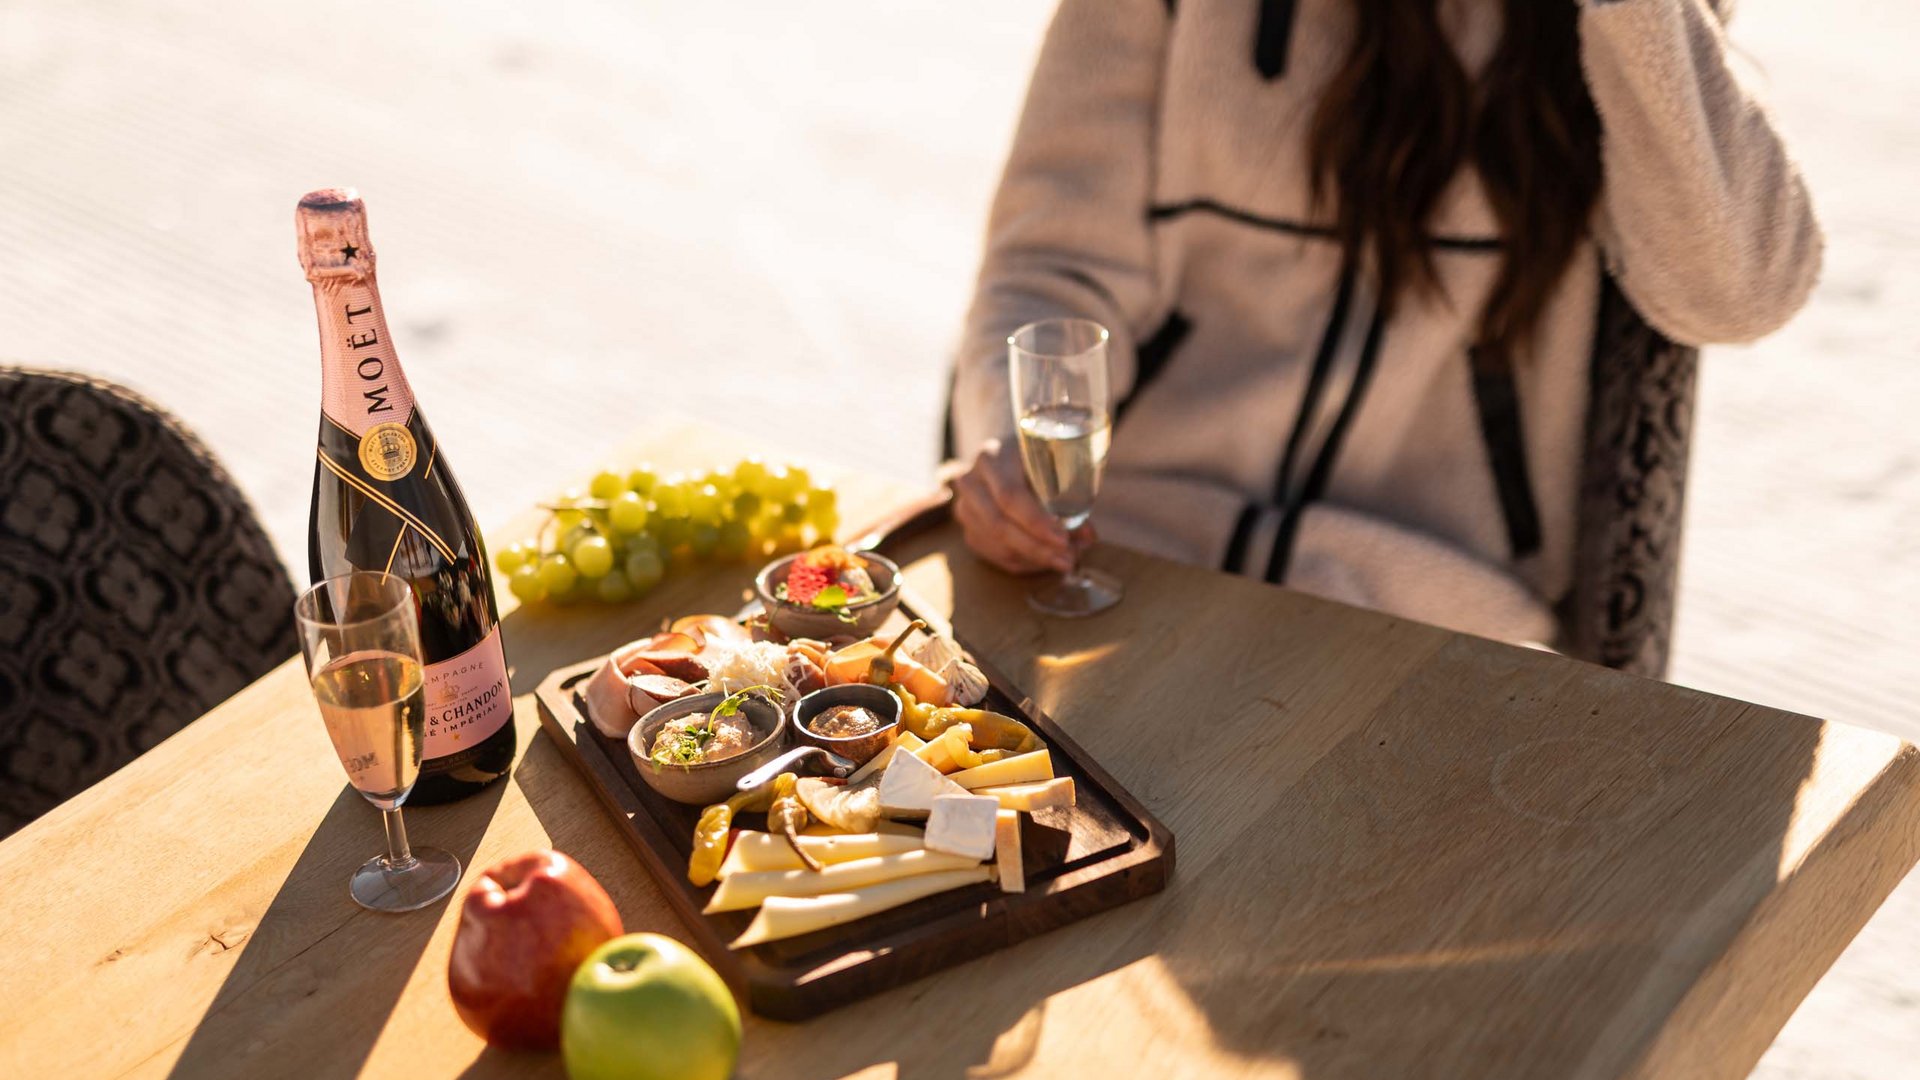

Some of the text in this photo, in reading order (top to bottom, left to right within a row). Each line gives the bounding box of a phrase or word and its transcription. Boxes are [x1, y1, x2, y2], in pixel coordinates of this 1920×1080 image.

[344, 304, 394, 415] MOËT
[424, 662, 484, 686] MPAGNE
[429, 716, 439, 726] &
[442, 677, 504, 722] CHANDON
[443, 703, 498, 734] IMPÉRIAL
